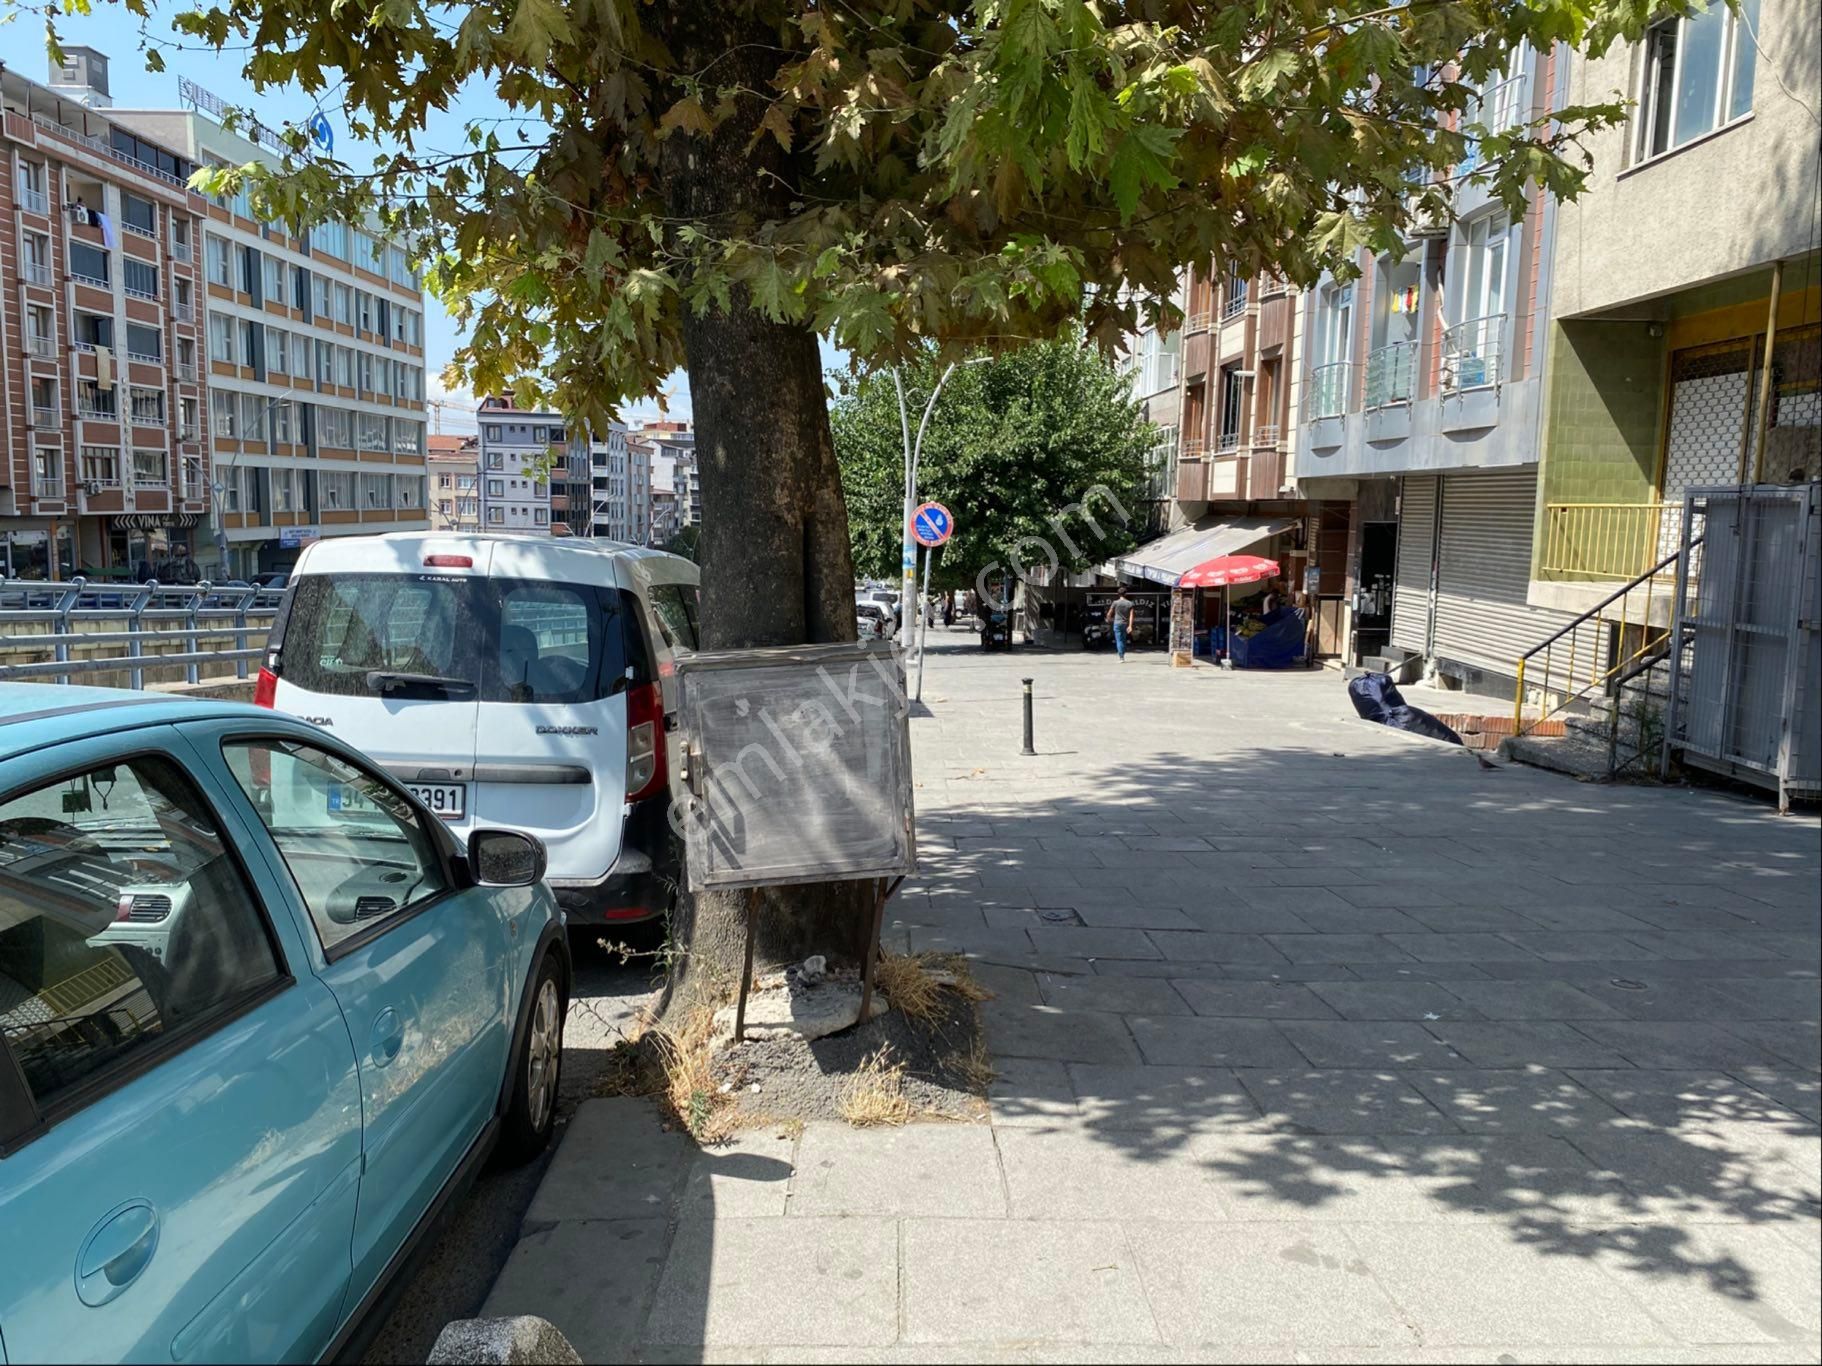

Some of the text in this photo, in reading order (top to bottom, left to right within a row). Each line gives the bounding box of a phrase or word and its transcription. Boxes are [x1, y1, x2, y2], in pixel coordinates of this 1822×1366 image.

[137, 515, 160, 528] VINA
[296, 715, 334, 727] ACIA
[535, 725, 599, 736] DOKKER
